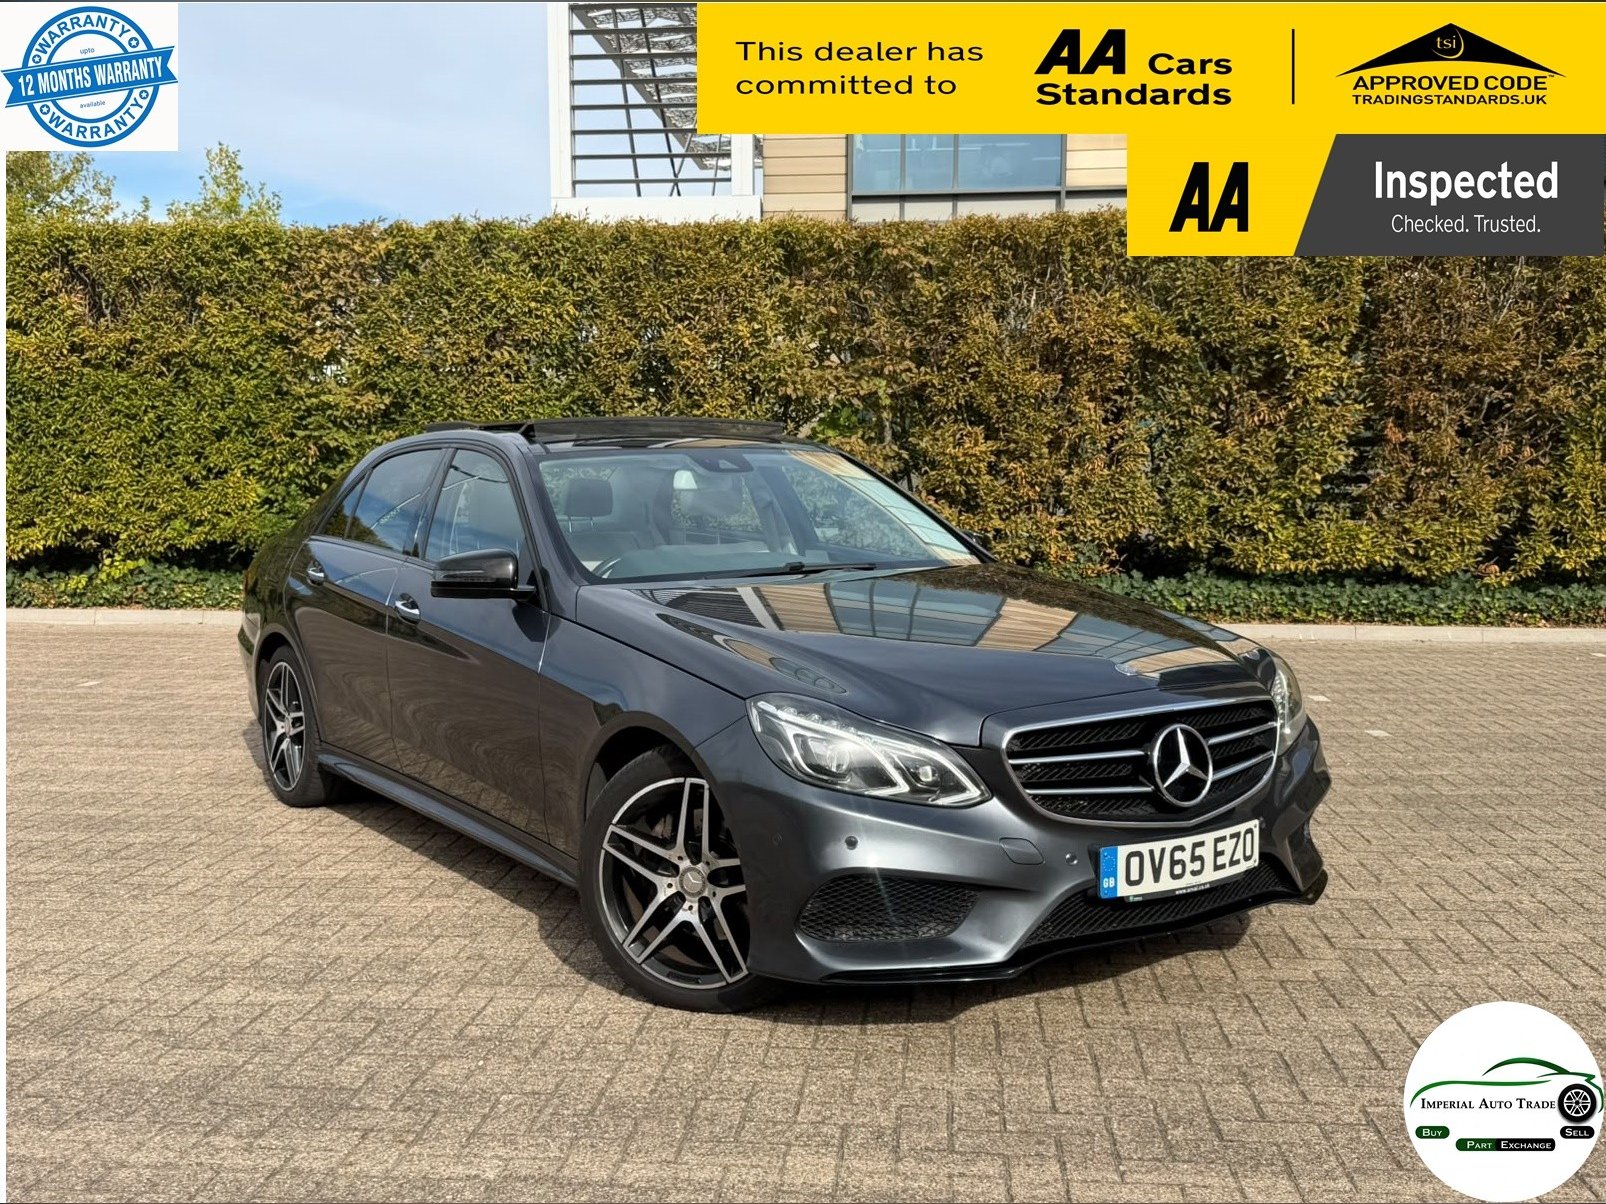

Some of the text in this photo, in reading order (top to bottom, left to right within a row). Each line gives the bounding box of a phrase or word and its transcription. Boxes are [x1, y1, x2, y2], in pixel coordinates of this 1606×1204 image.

[1125, 827, 1254, 887] OV65 EZO
[1103, 877, 1115, 888] GB
